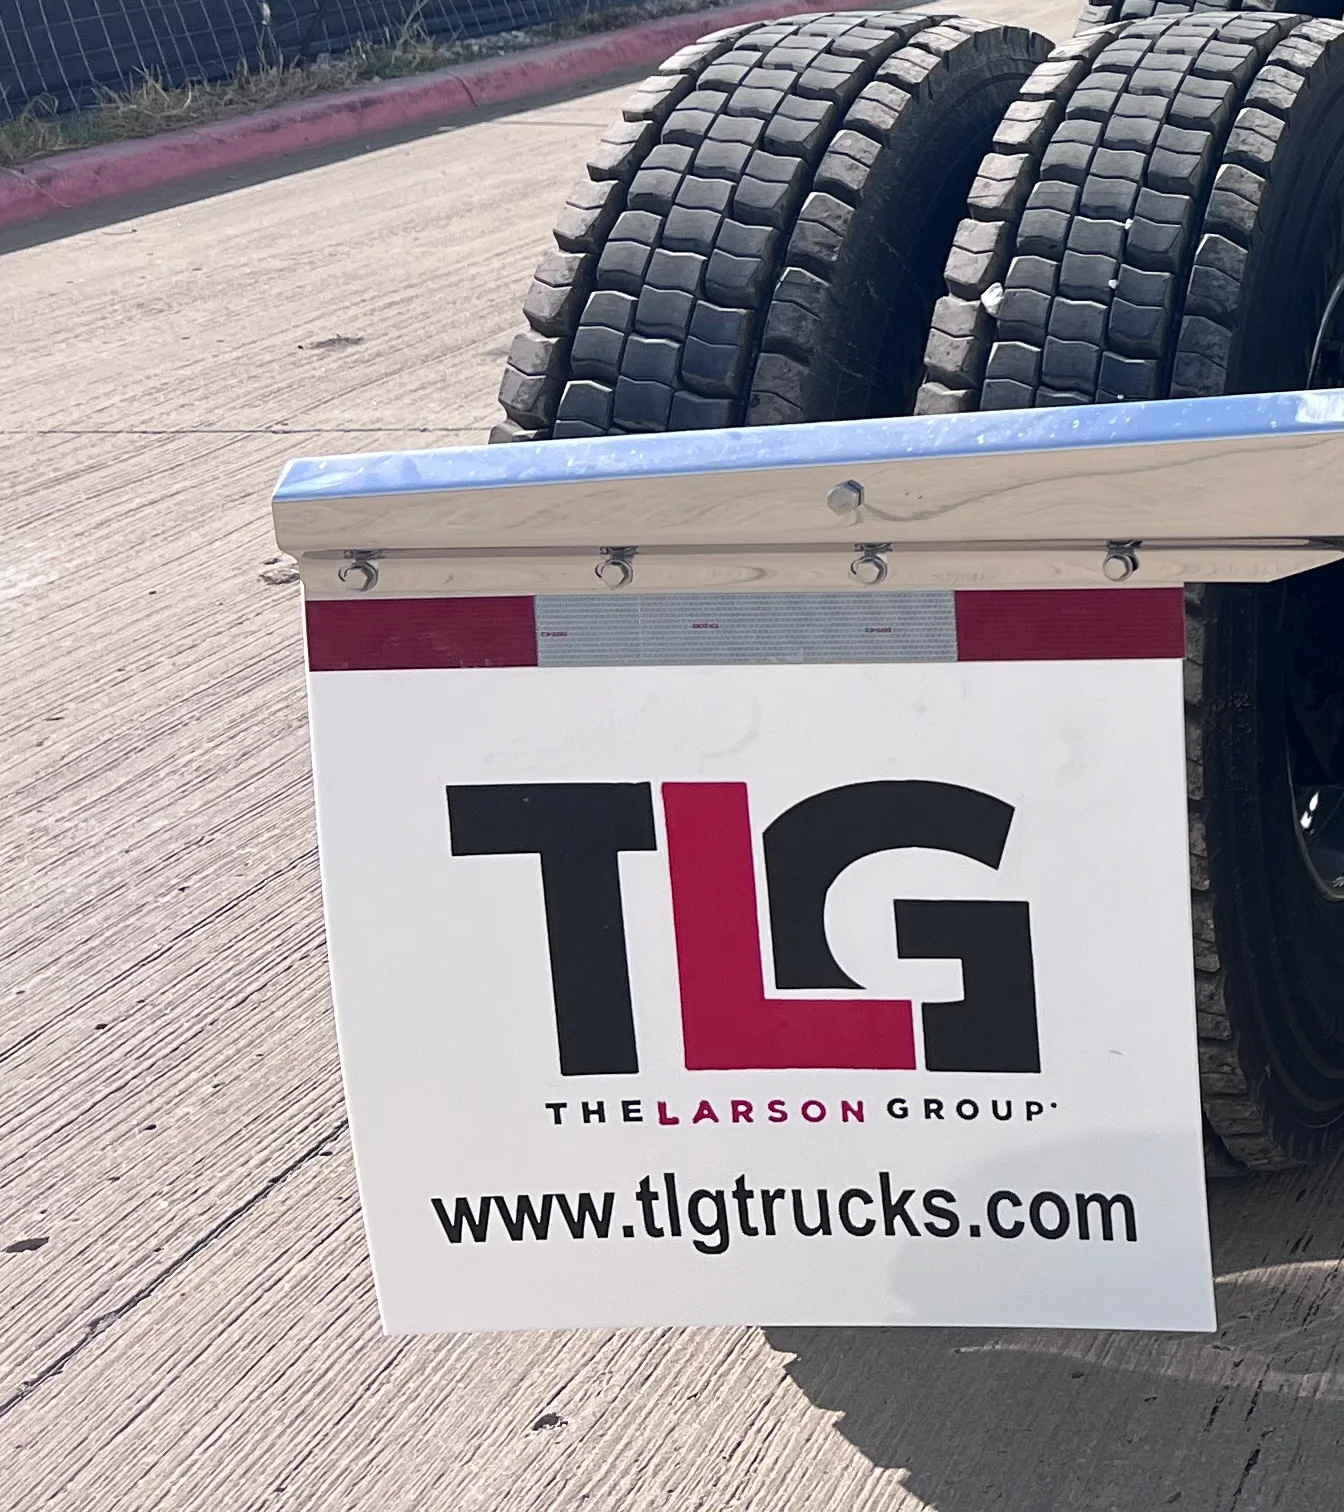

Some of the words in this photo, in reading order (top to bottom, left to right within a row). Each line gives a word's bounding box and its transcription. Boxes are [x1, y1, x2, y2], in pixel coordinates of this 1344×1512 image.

[445, 779, 1042, 1077] TLG
[886, 1097, 1044, 1122] GROUP
[430, 1171, 1138, 1255] www.tlgtrucks.com
